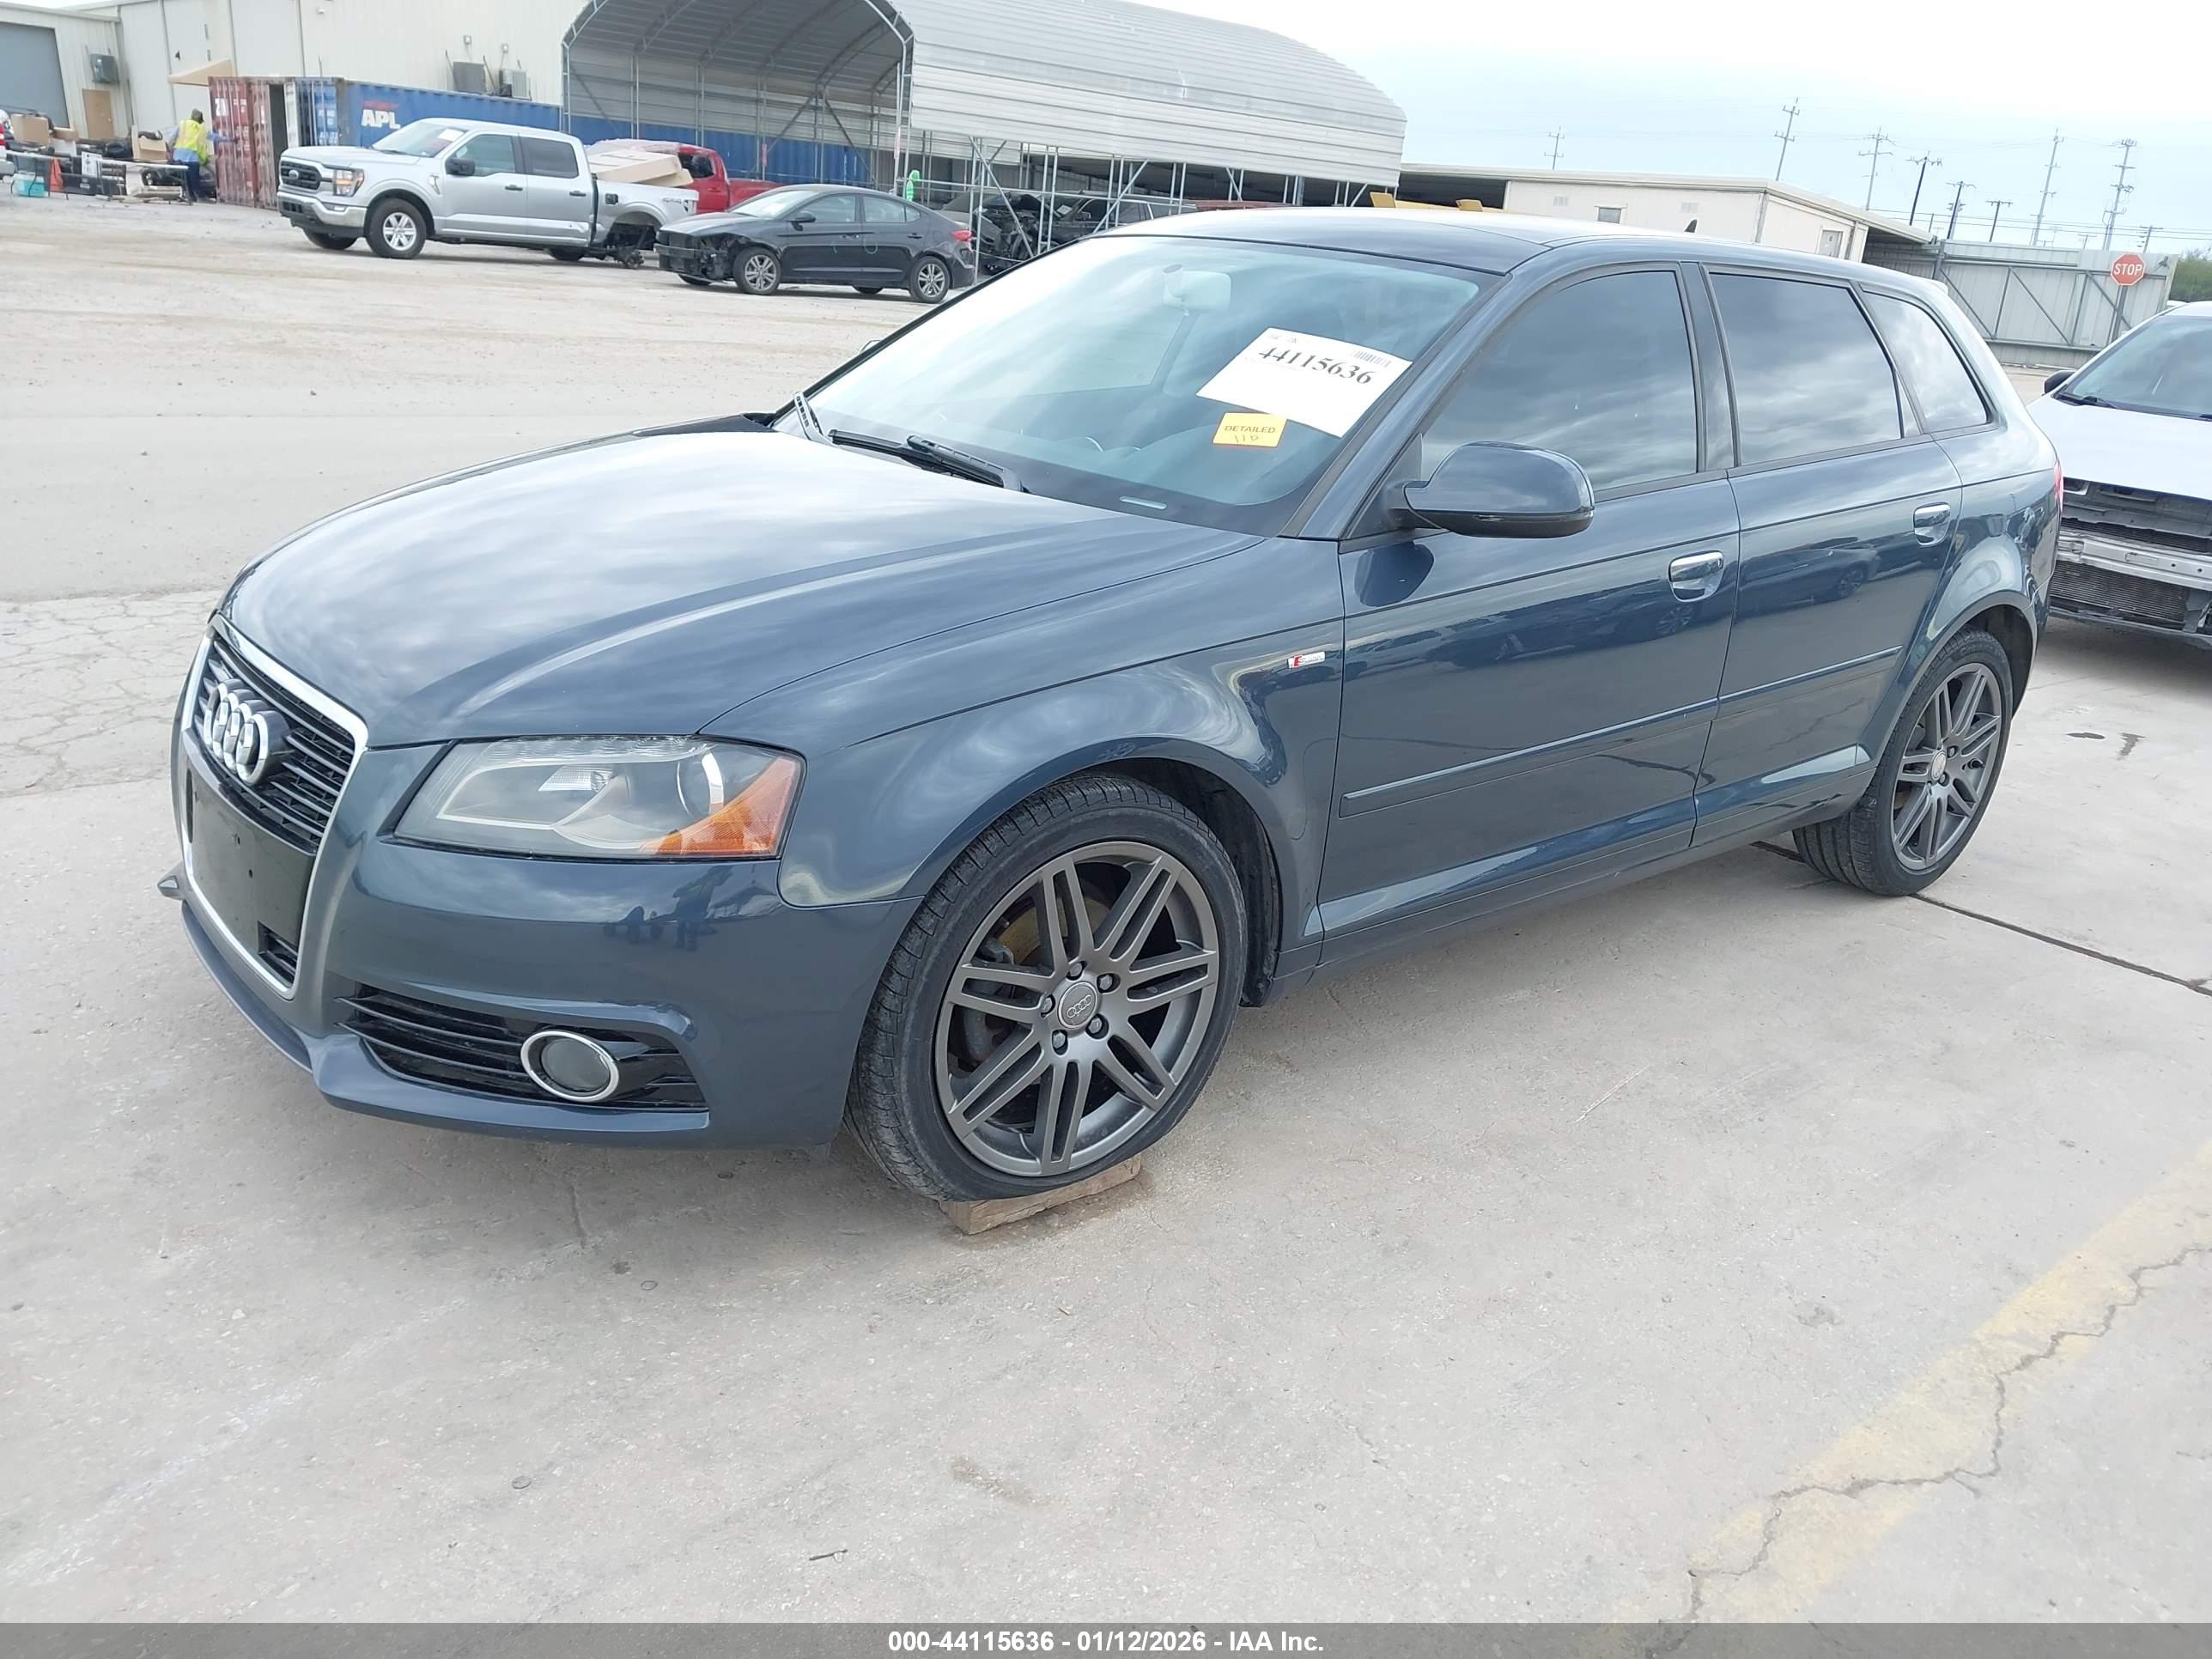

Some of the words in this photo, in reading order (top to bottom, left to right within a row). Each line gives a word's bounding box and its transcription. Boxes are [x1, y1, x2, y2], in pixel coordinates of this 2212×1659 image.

[361, 109, 402, 129] APL
[2113, 263, 2143, 276] STOP
[1258, 347, 1377, 385] 44115636
[1224, 425, 1276, 434] DETAILED
